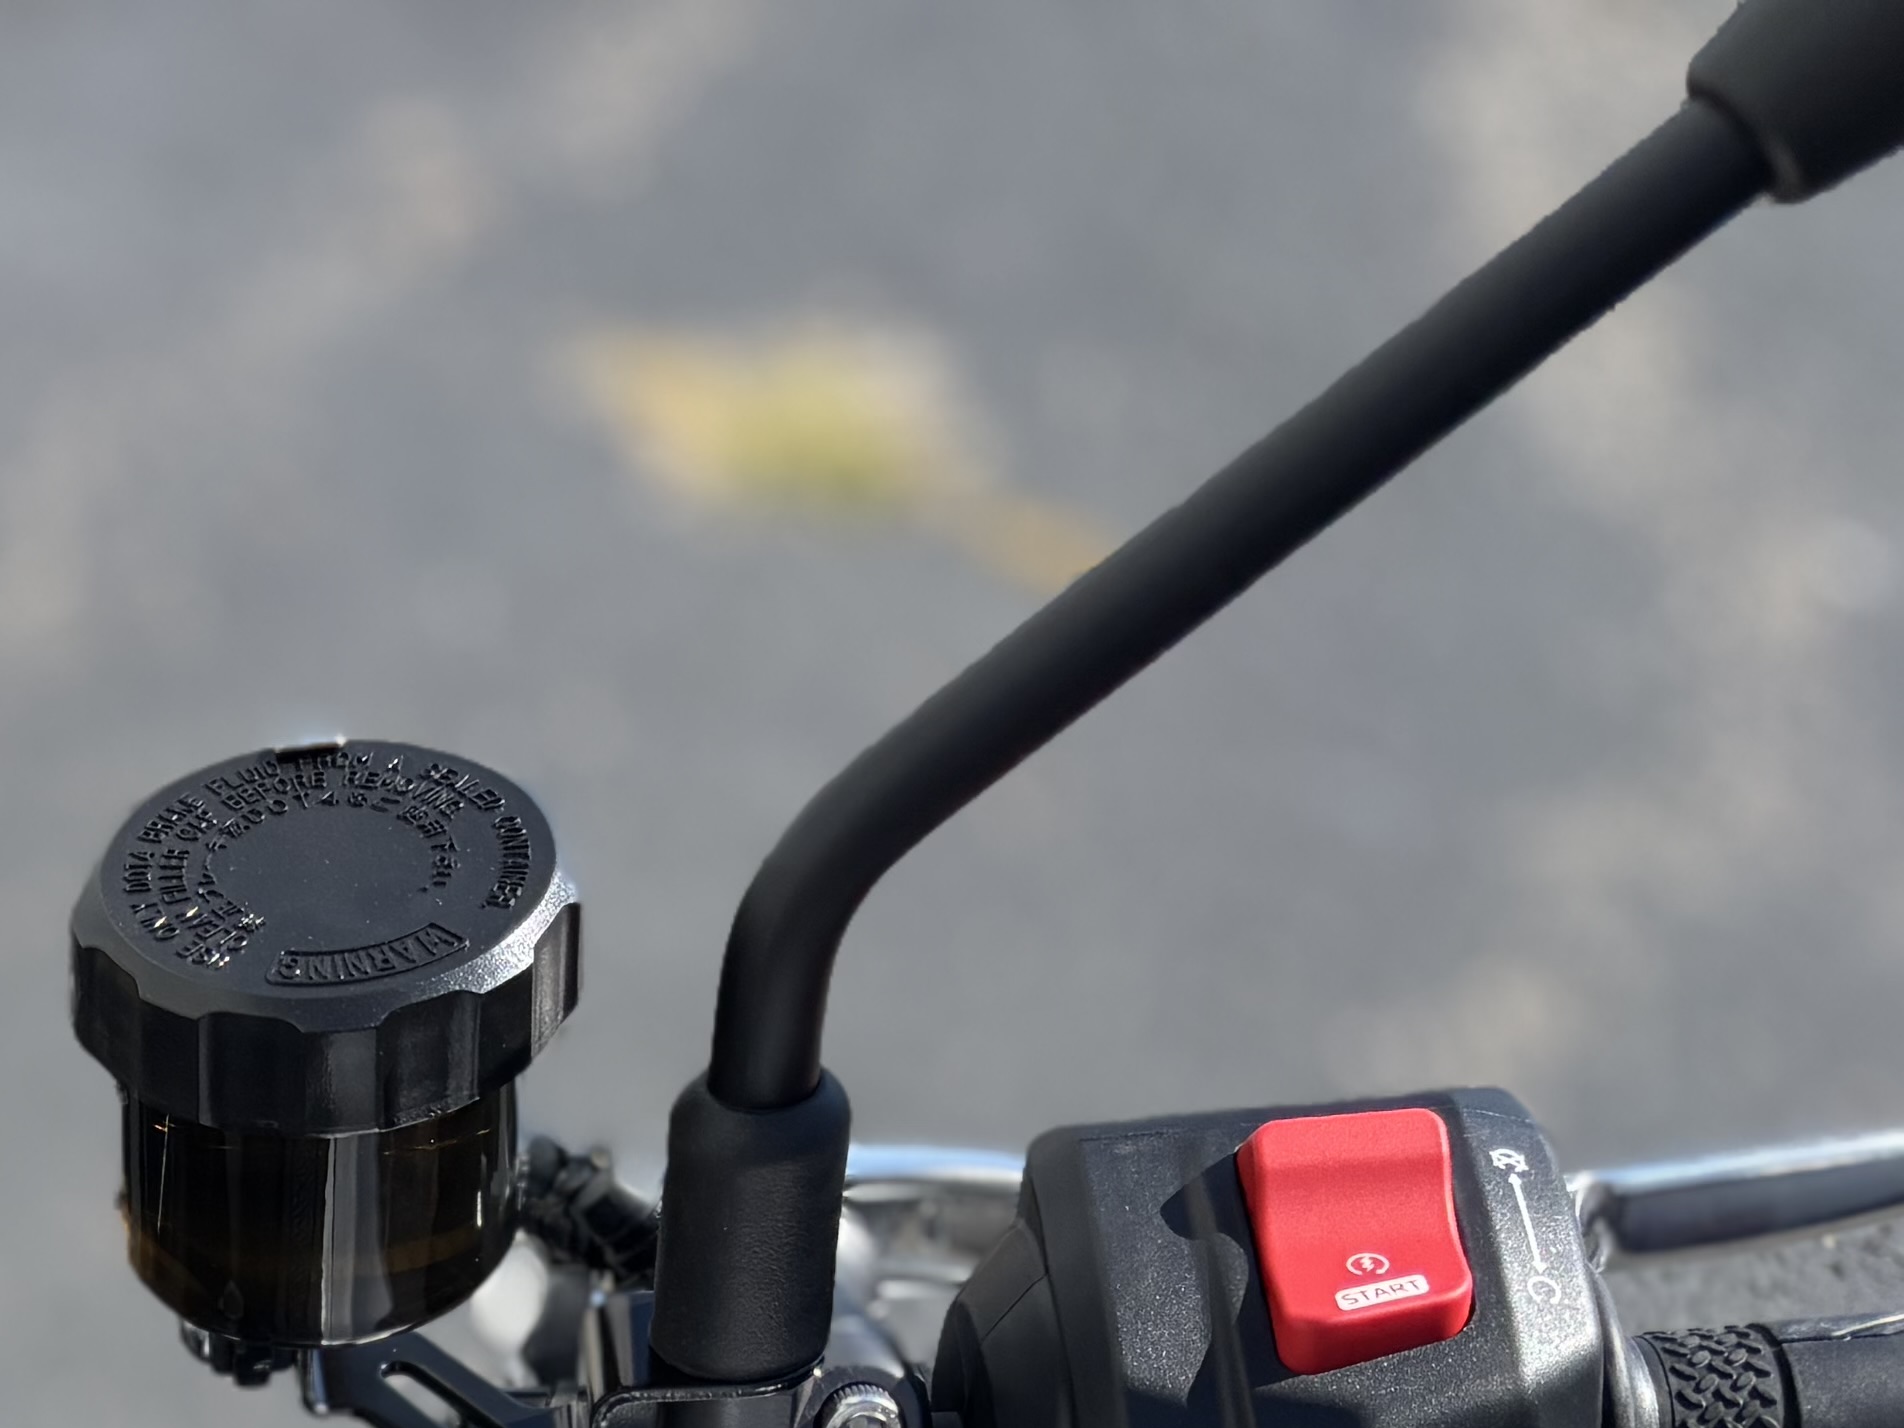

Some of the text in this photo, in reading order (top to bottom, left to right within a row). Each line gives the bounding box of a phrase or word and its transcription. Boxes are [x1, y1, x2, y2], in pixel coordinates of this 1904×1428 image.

[129, 902, 180, 942] ONLY
[202, 760, 280, 796] FLUID
[157, 849, 191, 905] FILLER
[221, 771, 328, 810] BEFORE
[279, 928, 457, 980] WARNING
[1341, 1279, 1421, 1305] START
